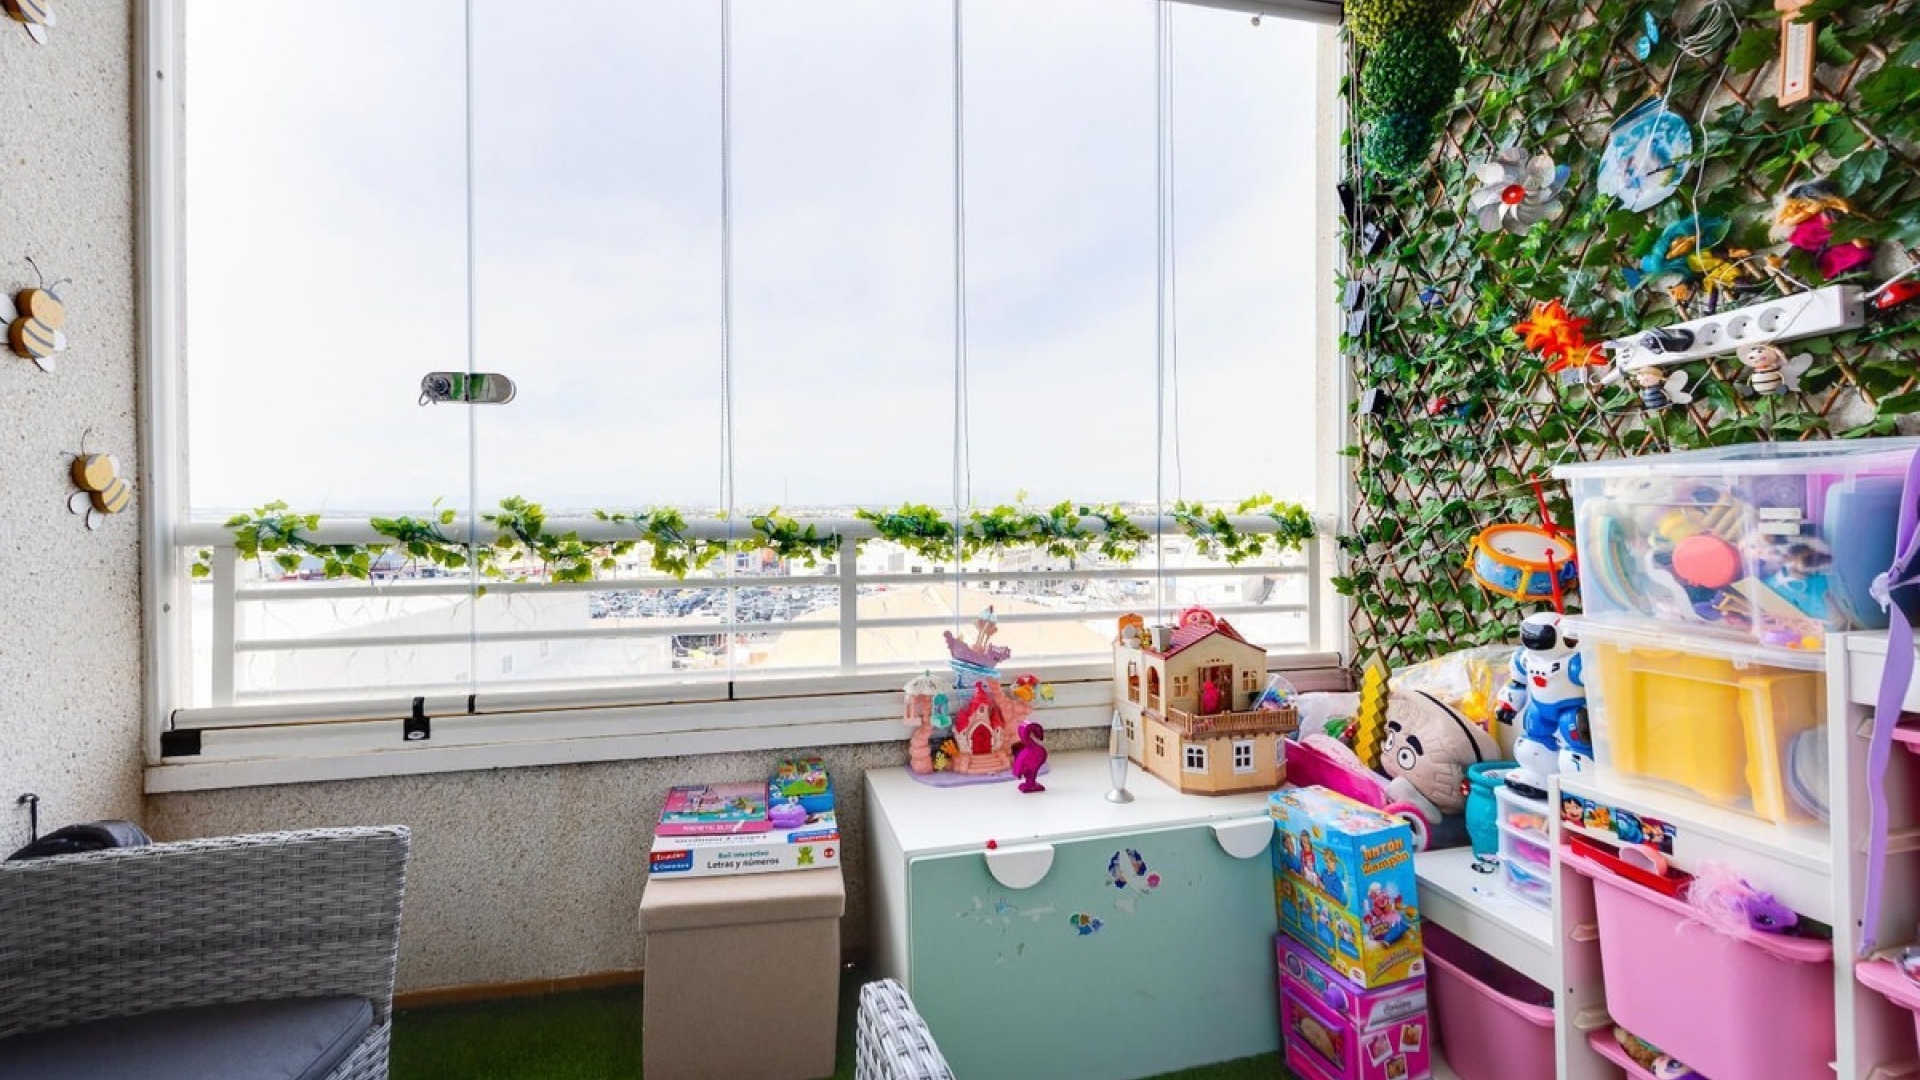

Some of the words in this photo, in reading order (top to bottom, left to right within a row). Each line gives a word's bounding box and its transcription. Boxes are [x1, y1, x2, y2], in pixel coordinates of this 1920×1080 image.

[707, 860, 734, 869] Letras
[736, 861, 741, 869] y
[743, 857, 780, 867] números
